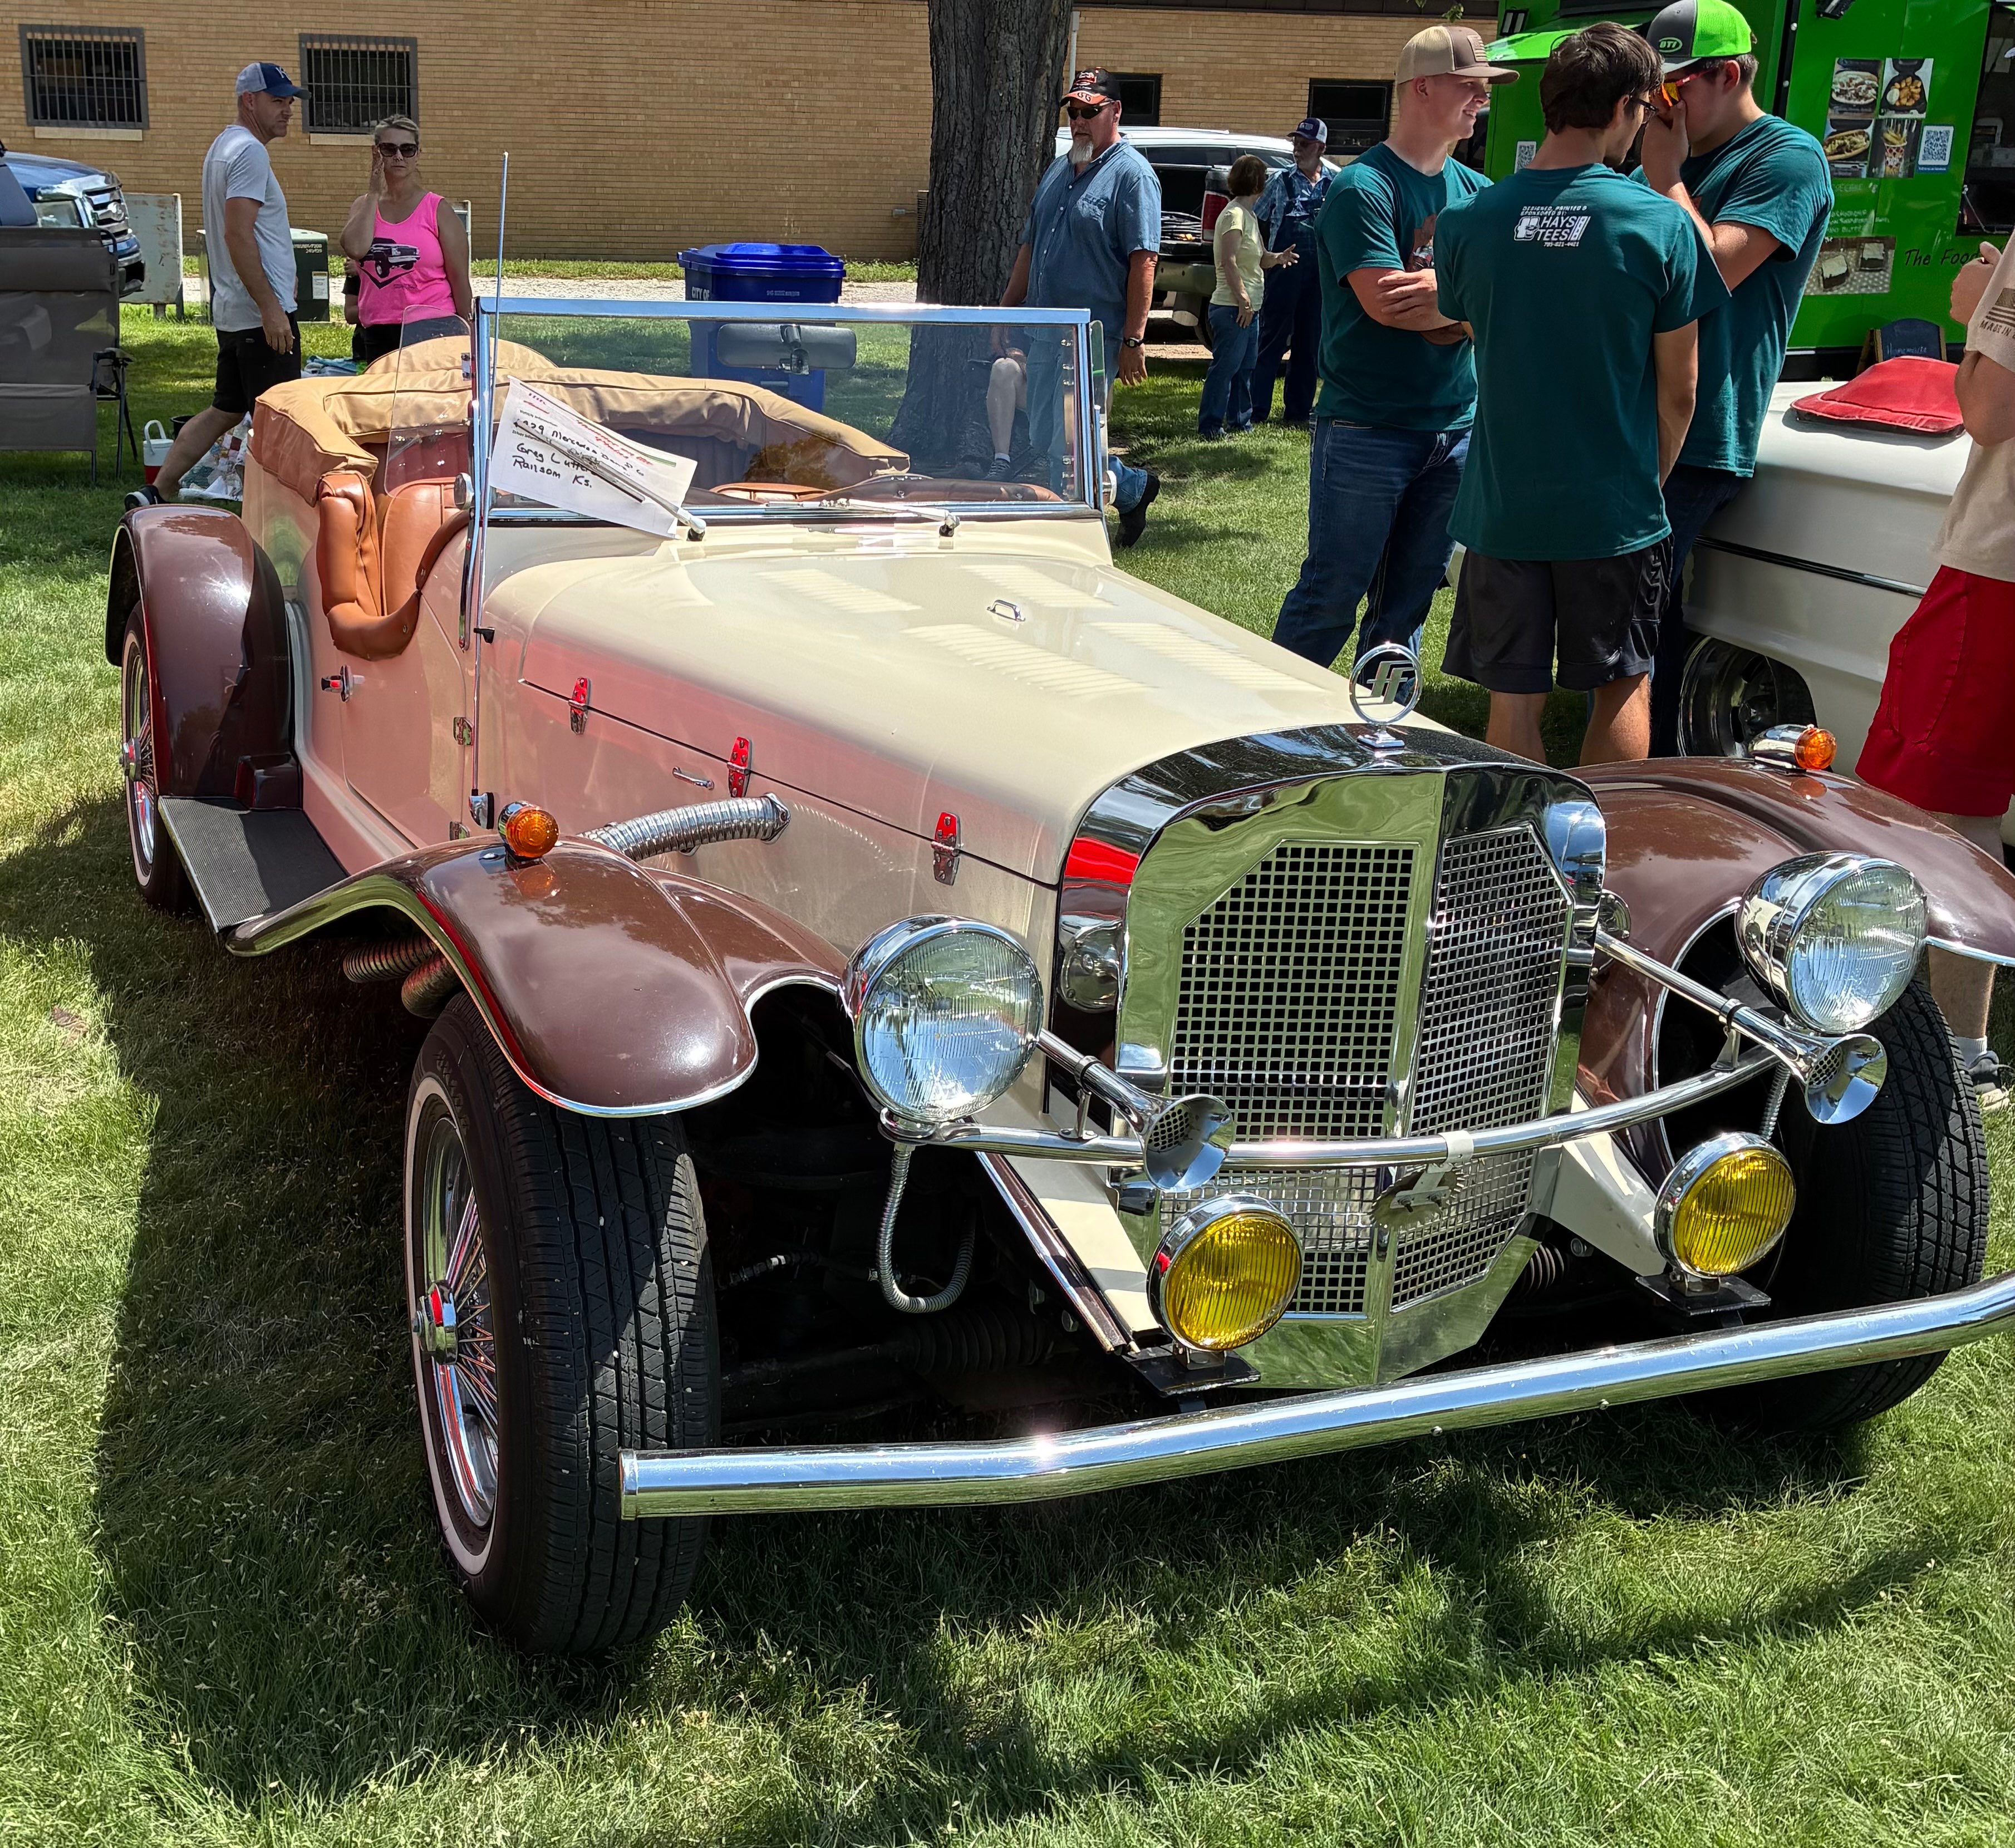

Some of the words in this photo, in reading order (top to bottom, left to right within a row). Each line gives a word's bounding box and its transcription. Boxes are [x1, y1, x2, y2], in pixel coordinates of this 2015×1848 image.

[1540, 216, 1578, 228] HAYS
[1537, 229, 1570, 240] TEES
[1905, 249, 1931, 266] The
[517, 443, 544, 463] Greg
